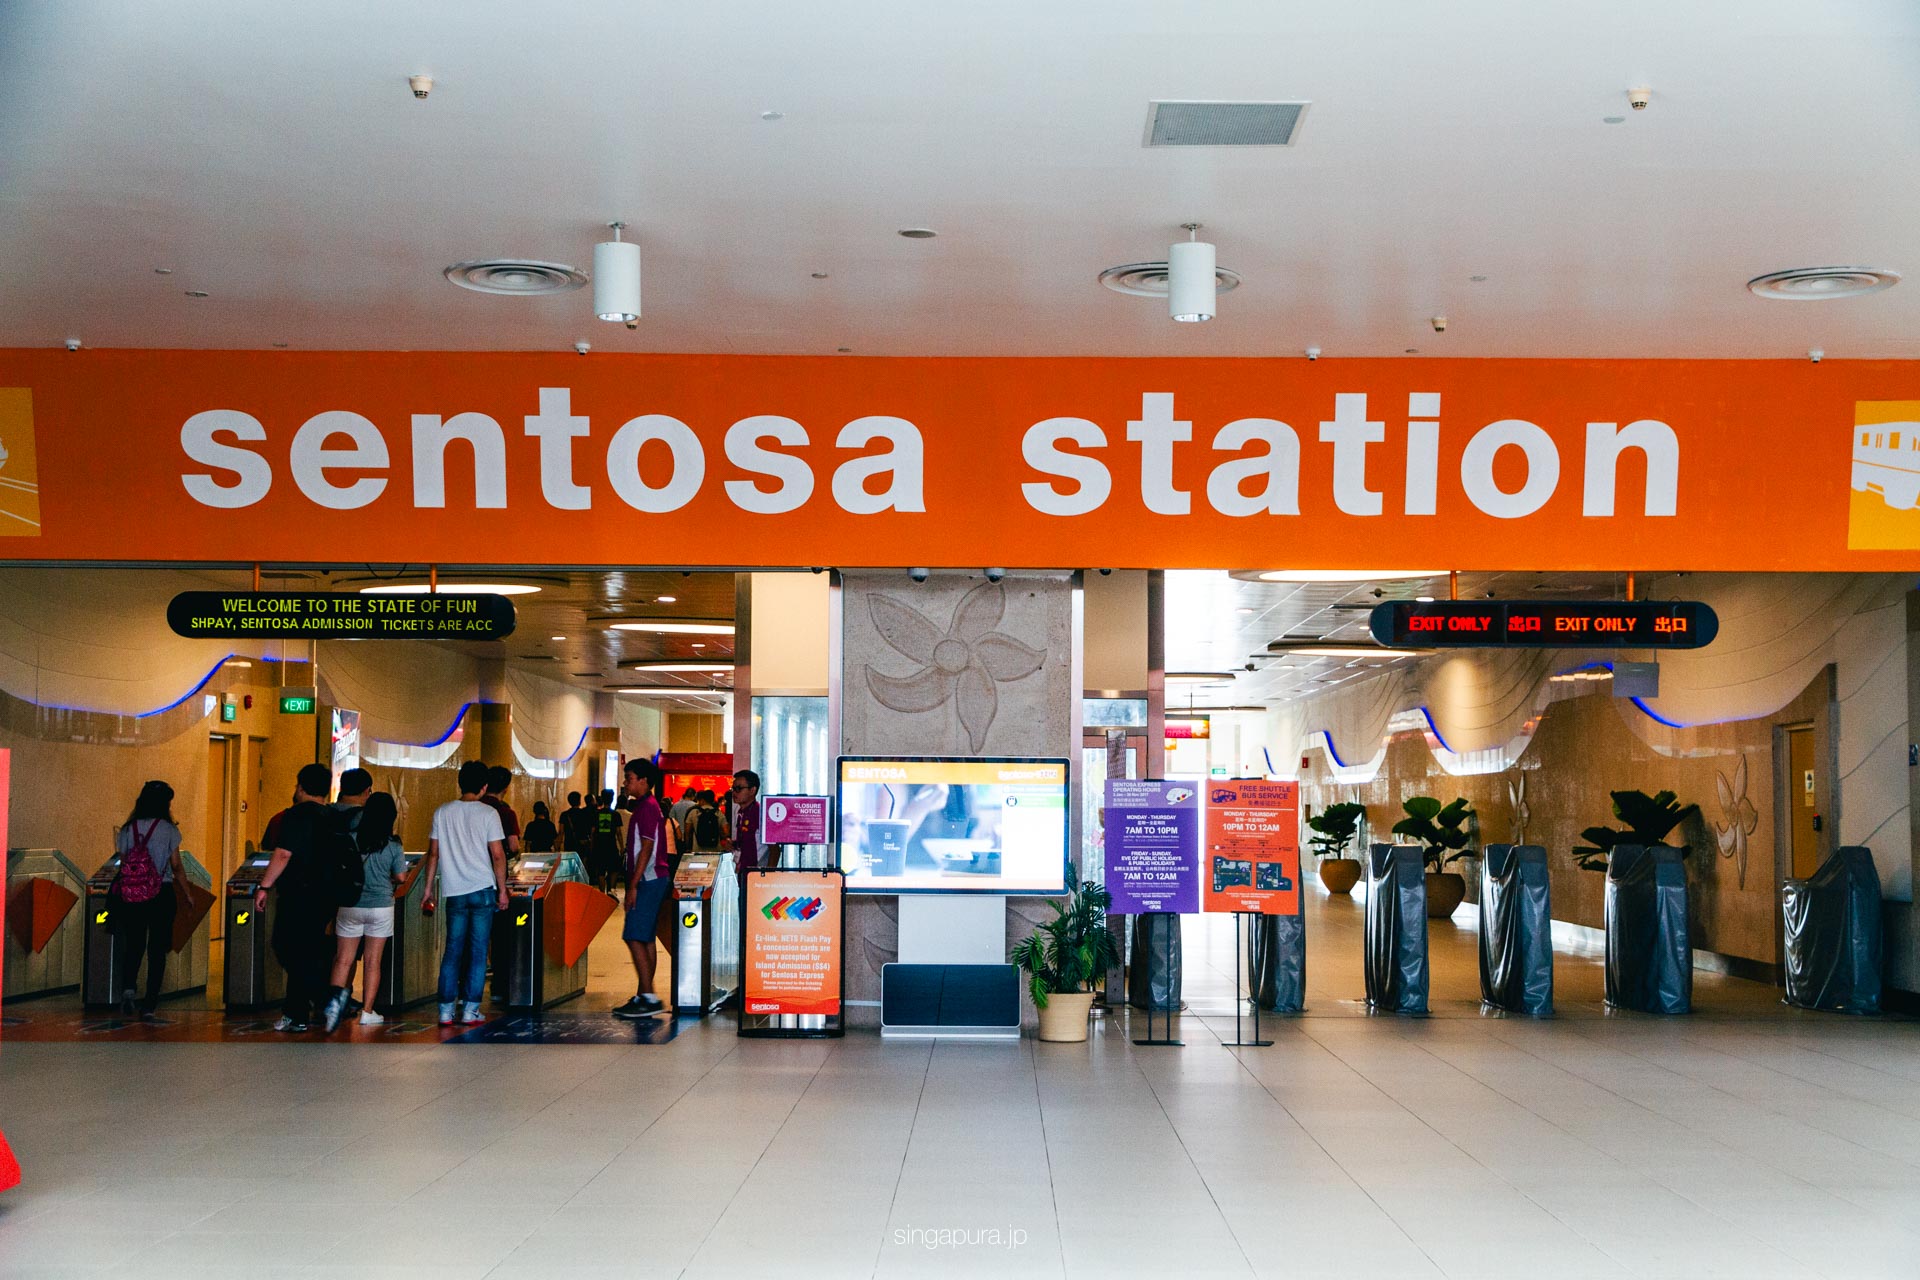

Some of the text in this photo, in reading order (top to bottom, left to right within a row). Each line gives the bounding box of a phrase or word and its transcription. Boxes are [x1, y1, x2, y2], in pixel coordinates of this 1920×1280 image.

[179, 386, 1680, 519] sentosa station
[222, 598, 478, 613] WELCOME TO THE STATE OF FUN
[191, 617, 236, 631] SHPAY,
[240, 618, 299, 630] SENTOSA
[302, 618, 373, 630] ADMISSION
[381, 619, 434, 632] TICKETS
[438, 619, 462, 632] ARE
[1408, 616, 1492, 631] EXIT ONLY
[1508, 616, 1541, 632] 出口
[1554, 617, 1637, 632] EXIT ONLY
[1654, 617, 1687, 632] 出口
[290, 700, 311, 712] EXIT
[848, 768, 907, 779] SENTOSA
[820, 936, 831, 944] Pay
[781, 954, 809, 962] accepted
